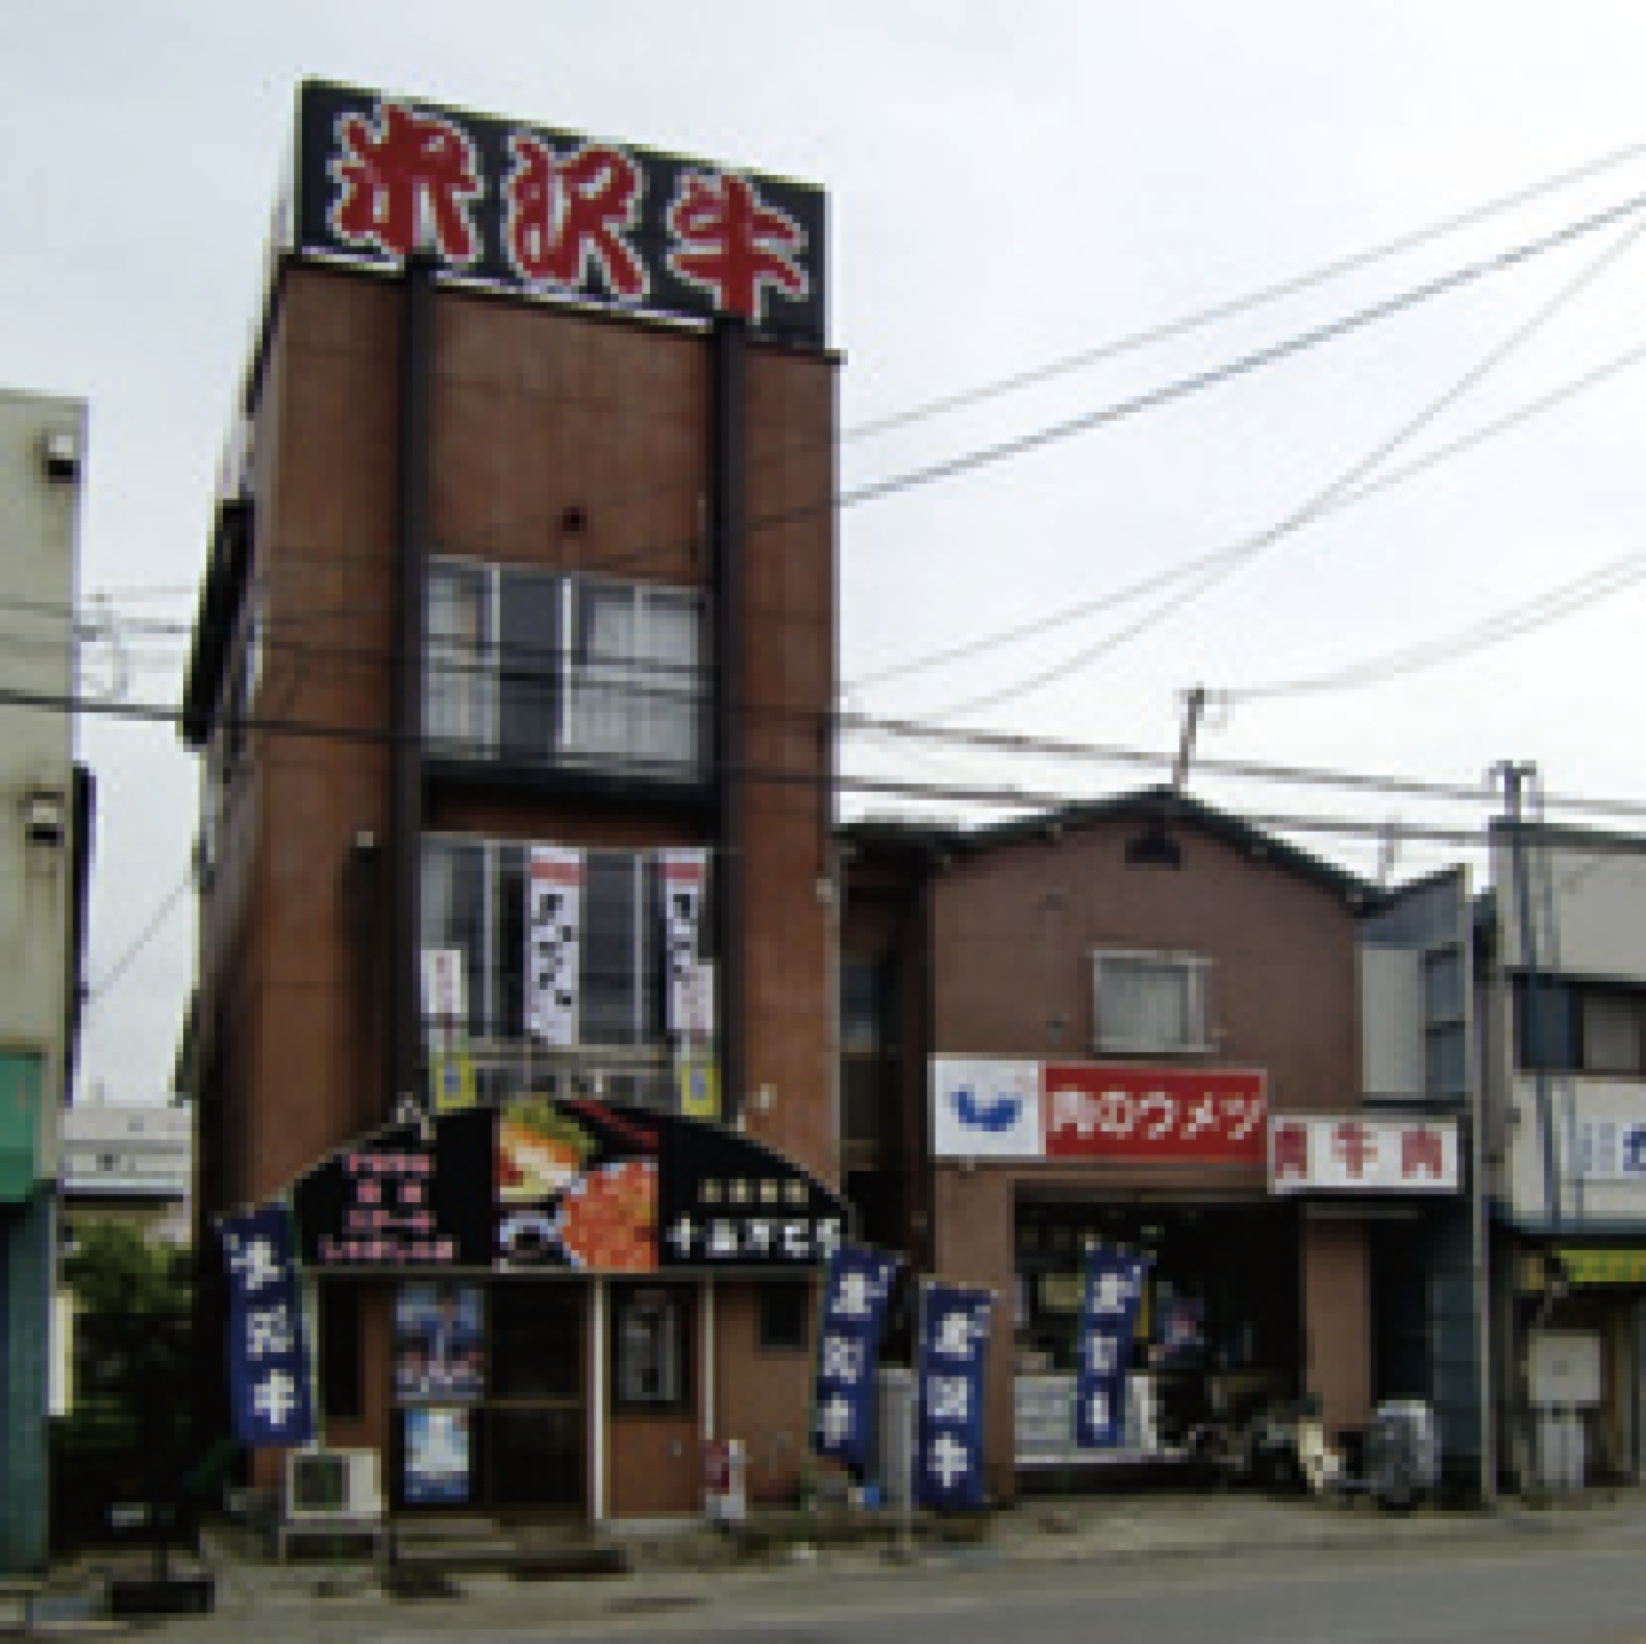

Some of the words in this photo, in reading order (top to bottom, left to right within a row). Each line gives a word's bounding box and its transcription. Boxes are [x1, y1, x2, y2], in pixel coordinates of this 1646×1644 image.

[328, 100, 810, 318] 米沢牛
[1051, 1087, 1262, 1141] 肉のウメツ
